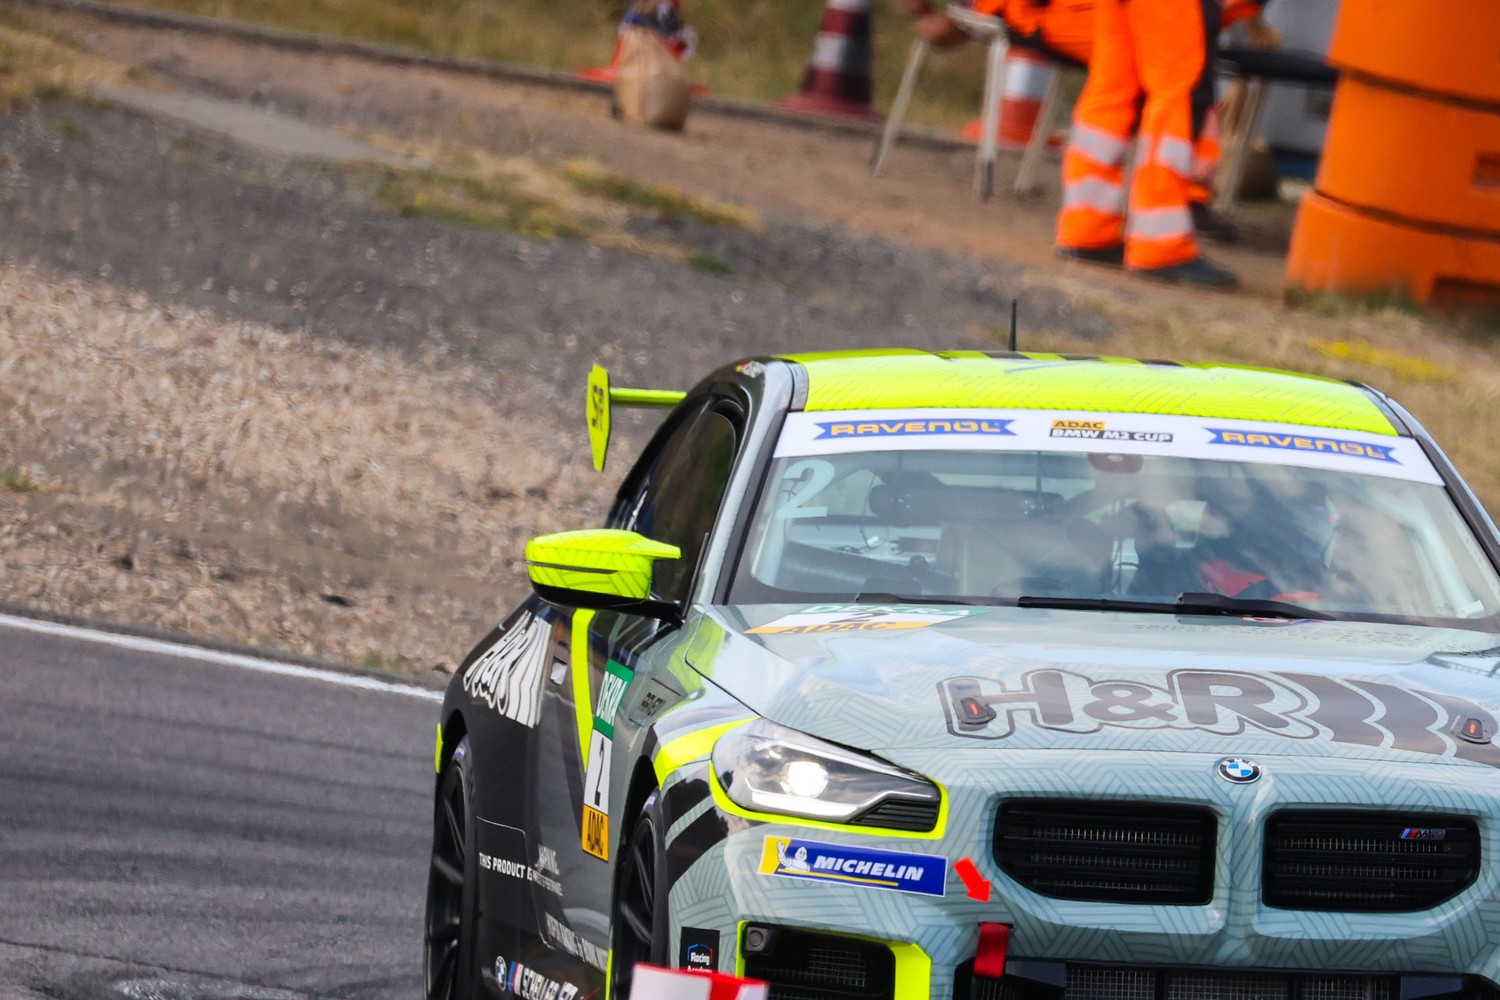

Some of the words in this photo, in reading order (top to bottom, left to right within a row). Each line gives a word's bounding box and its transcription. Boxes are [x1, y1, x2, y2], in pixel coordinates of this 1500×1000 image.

[830, 421, 999, 436] RAVENOL
[1051, 428, 1100, 440] BMW
[1102, 430, 1131, 441] M2
[1133, 431, 1173, 443] CUP
[1053, 420, 1104, 430] ADAC
[1222, 431, 1388, 460] RAVENOL
[777, 458, 836, 519] 2
[801, 604, 970, 617] DEKRA
[936, 668, 1321, 741] H&R
[478, 851, 492, 870] THIS
[492, 857, 526, 879] PRODUCT
[813, 855, 925, 882] MICHELIN
[690, 952, 710, 966] Racing
